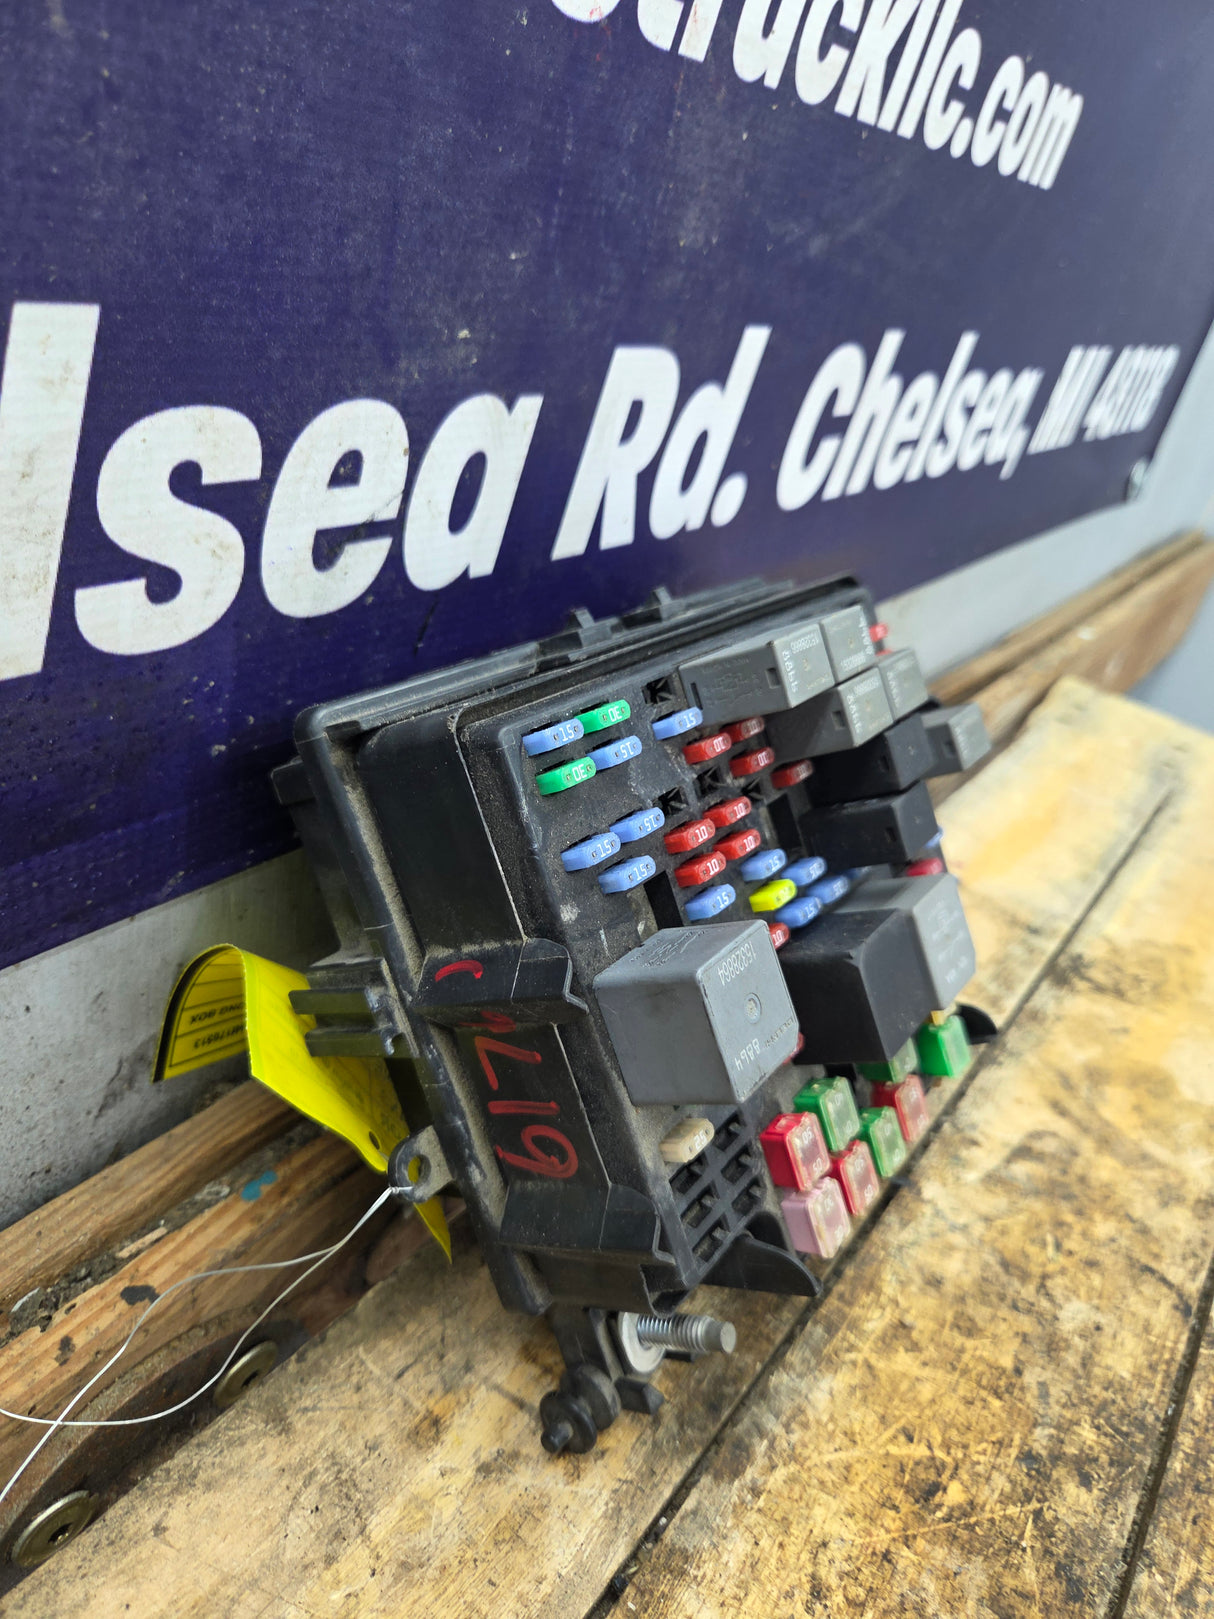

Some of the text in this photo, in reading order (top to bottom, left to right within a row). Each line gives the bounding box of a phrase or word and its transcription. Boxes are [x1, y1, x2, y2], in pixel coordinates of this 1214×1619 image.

[0, 301, 543, 680] lsea
[551, 323, 772, 561] Rd.
[776, 329, 1044, 510] Chelsea,
[1026, 344, 1113, 455] MI
[608, 706, 624, 722] 30
[684, 714, 697, 728] 15
[559, 724, 574, 742] 15
[620, 744, 633, 758] 15
[713, 738, 725, 750] 10
[758, 751, 769, 761] 10
[572, 764, 588, 782] 30
[734, 803, 746, 818] 10
[643, 814, 657, 828] 15
[695, 825, 708, 842] 10
[599, 840, 612, 857] 15
[743, 835, 755, 851] 10
[706, 859, 719, 876] 10
[769, 856, 780, 870] 15
[633, 864, 648, 880] 15
[716, 895, 729, 910] 15
[806, 904, 818, 918] 15
[773, 930, 784, 946] 10
[718, 941, 757, 986] 15328864
[693, 1130, 707, 1151] 25
[813, 1157, 823, 1176] 50
